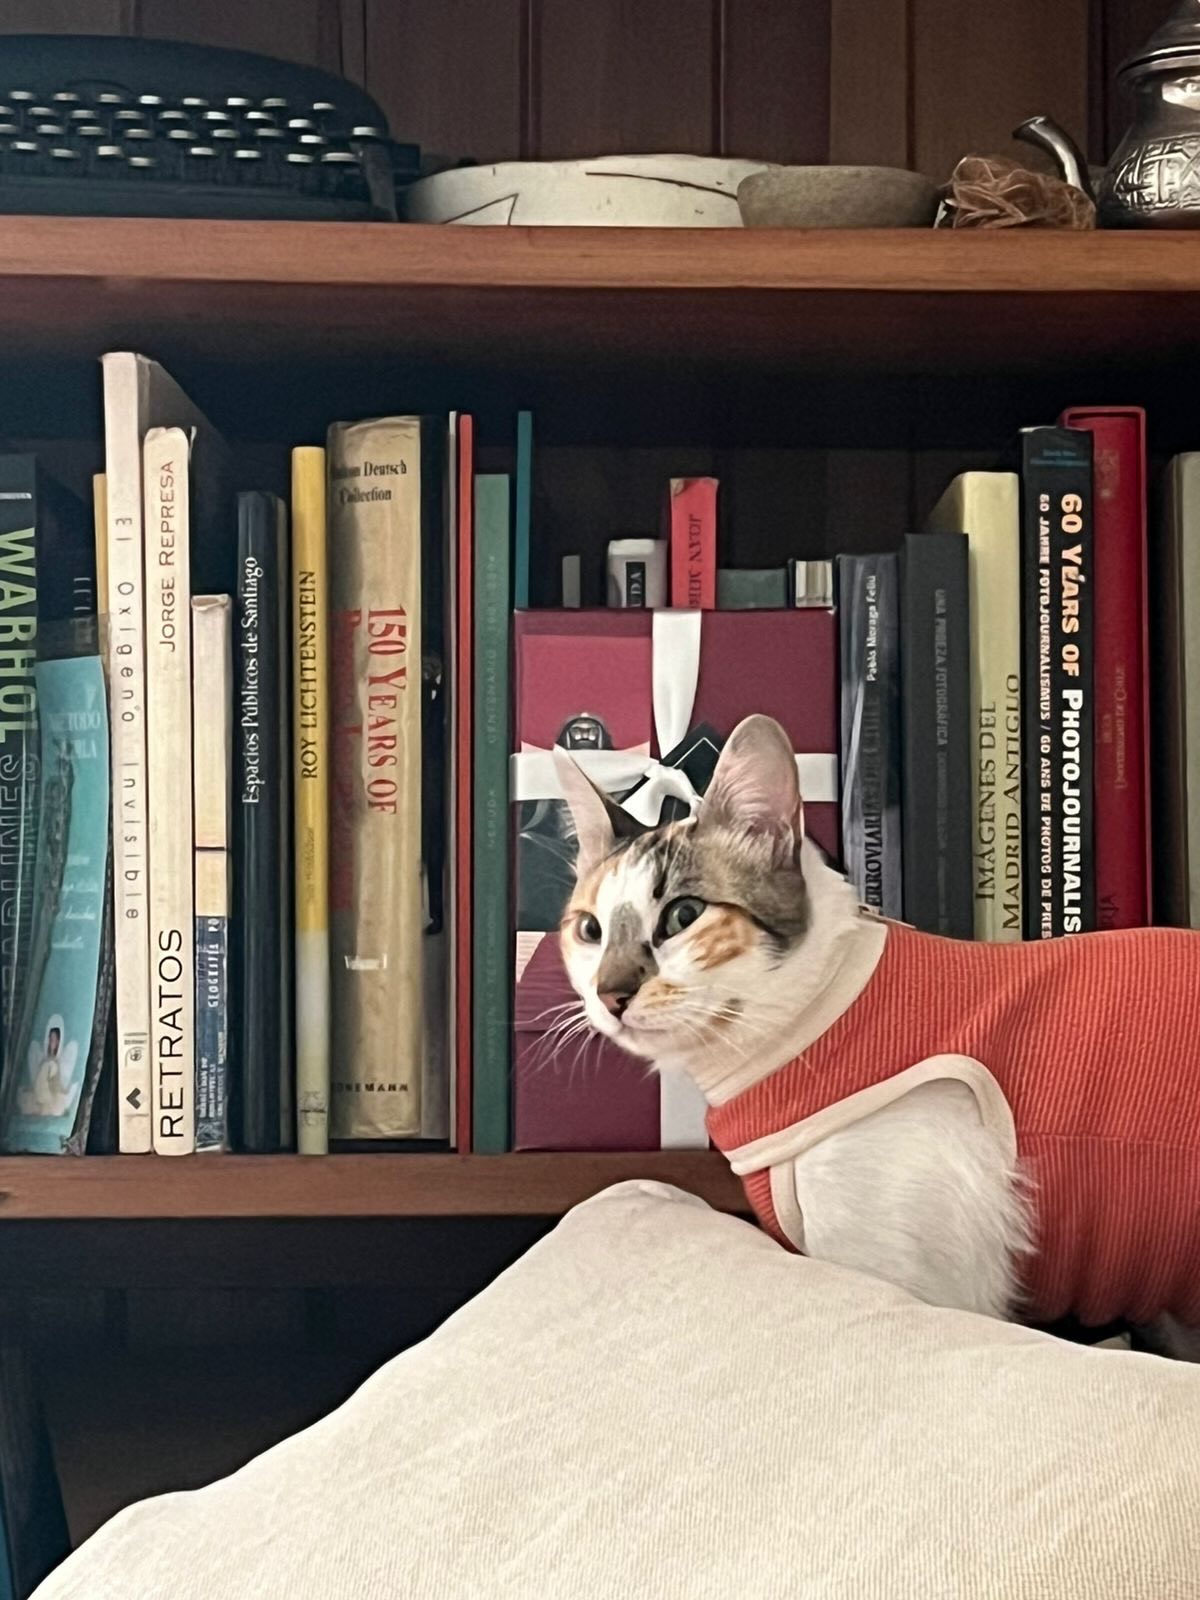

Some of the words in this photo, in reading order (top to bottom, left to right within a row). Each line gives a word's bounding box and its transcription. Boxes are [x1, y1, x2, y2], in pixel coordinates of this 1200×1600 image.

[159, 460, 174, 567] REPRESA
[1061, 493, 1083, 534] 60
[159, 576, 176, 653] JORGE
[241, 557, 264, 628] Santiago
[1061, 545, 1083, 634] YEARS
[0, 526, 38, 743] WARHOL
[241, 632, 259, 653] de
[299, 571, 316, 727] LICHTENSTEIN
[367, 605, 407, 655] 150
[1061, 644, 1081, 677] OF
[241, 658, 259, 727] Públicos
[367, 667, 407, 768] YEARS
[979, 701, 996, 753] DEL
[242, 733, 265, 804] Espacios
[301, 735, 318, 779] ROY
[367, 778, 398, 815] OF
[1062, 689, 1083, 937] PHOTOJOURNALIS
[1002, 812, 1020, 930] MADRID
[159, 928, 184, 1139] RETRATOS
